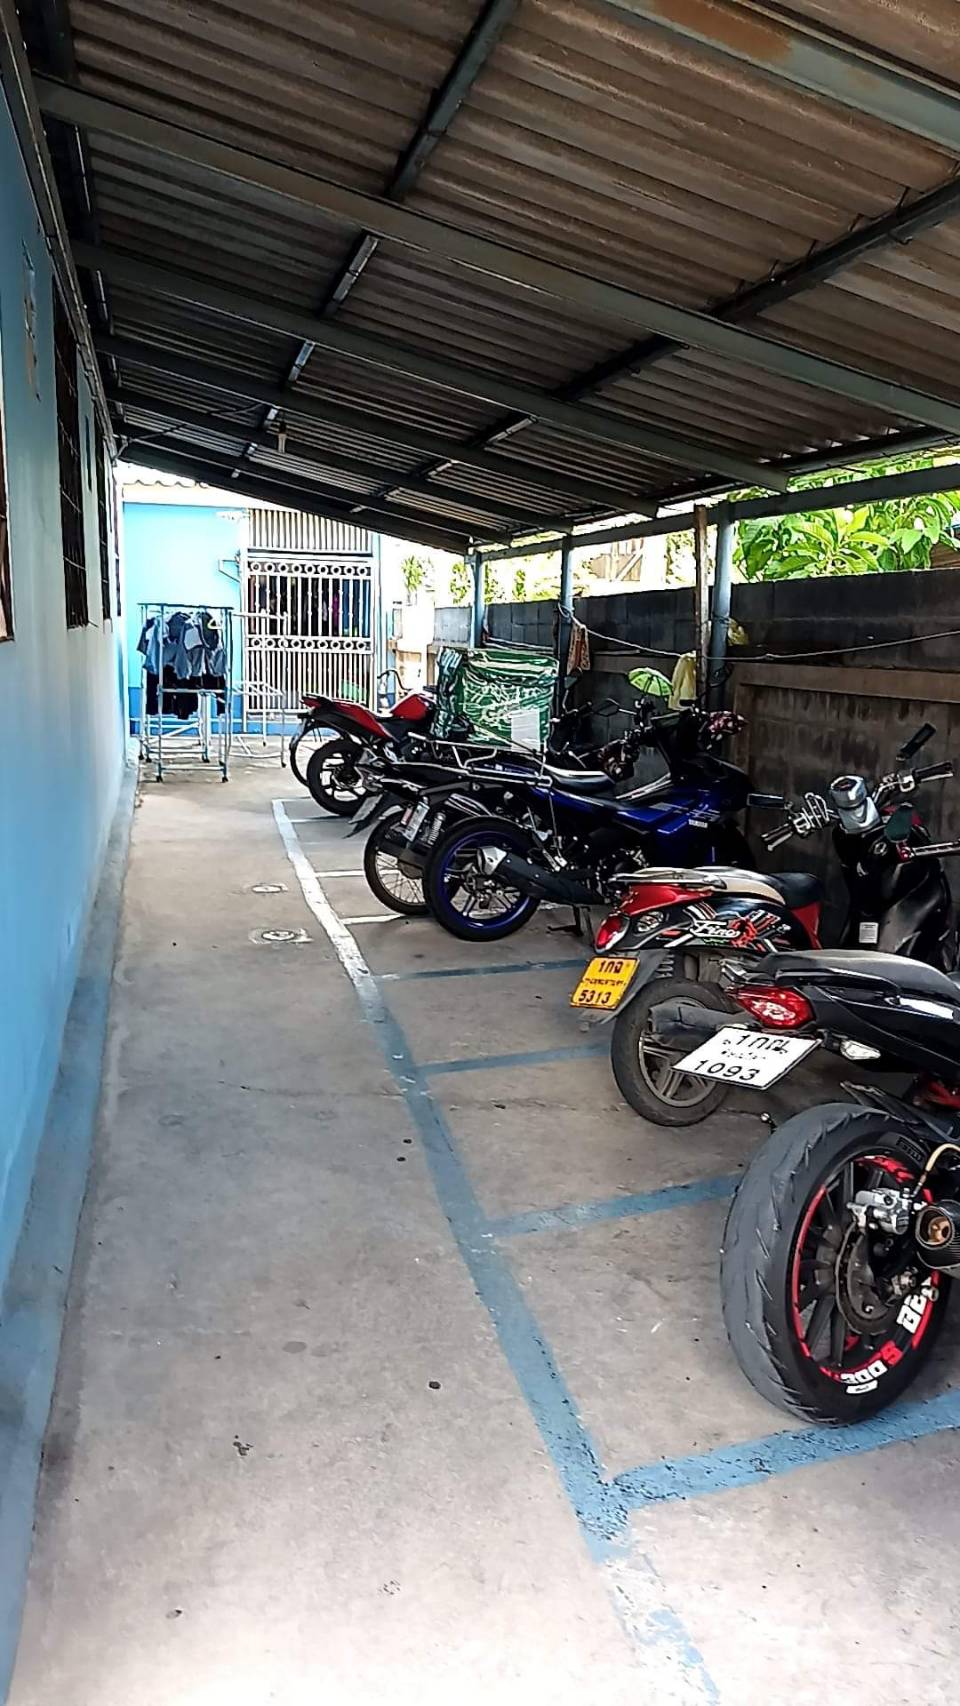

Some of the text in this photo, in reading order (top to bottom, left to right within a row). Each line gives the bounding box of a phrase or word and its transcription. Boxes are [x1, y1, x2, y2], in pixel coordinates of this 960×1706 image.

[690, 919, 740, 938] Fino
[578, 989, 612, 1004] 5313
[694, 1059, 761, 1081] 1093
